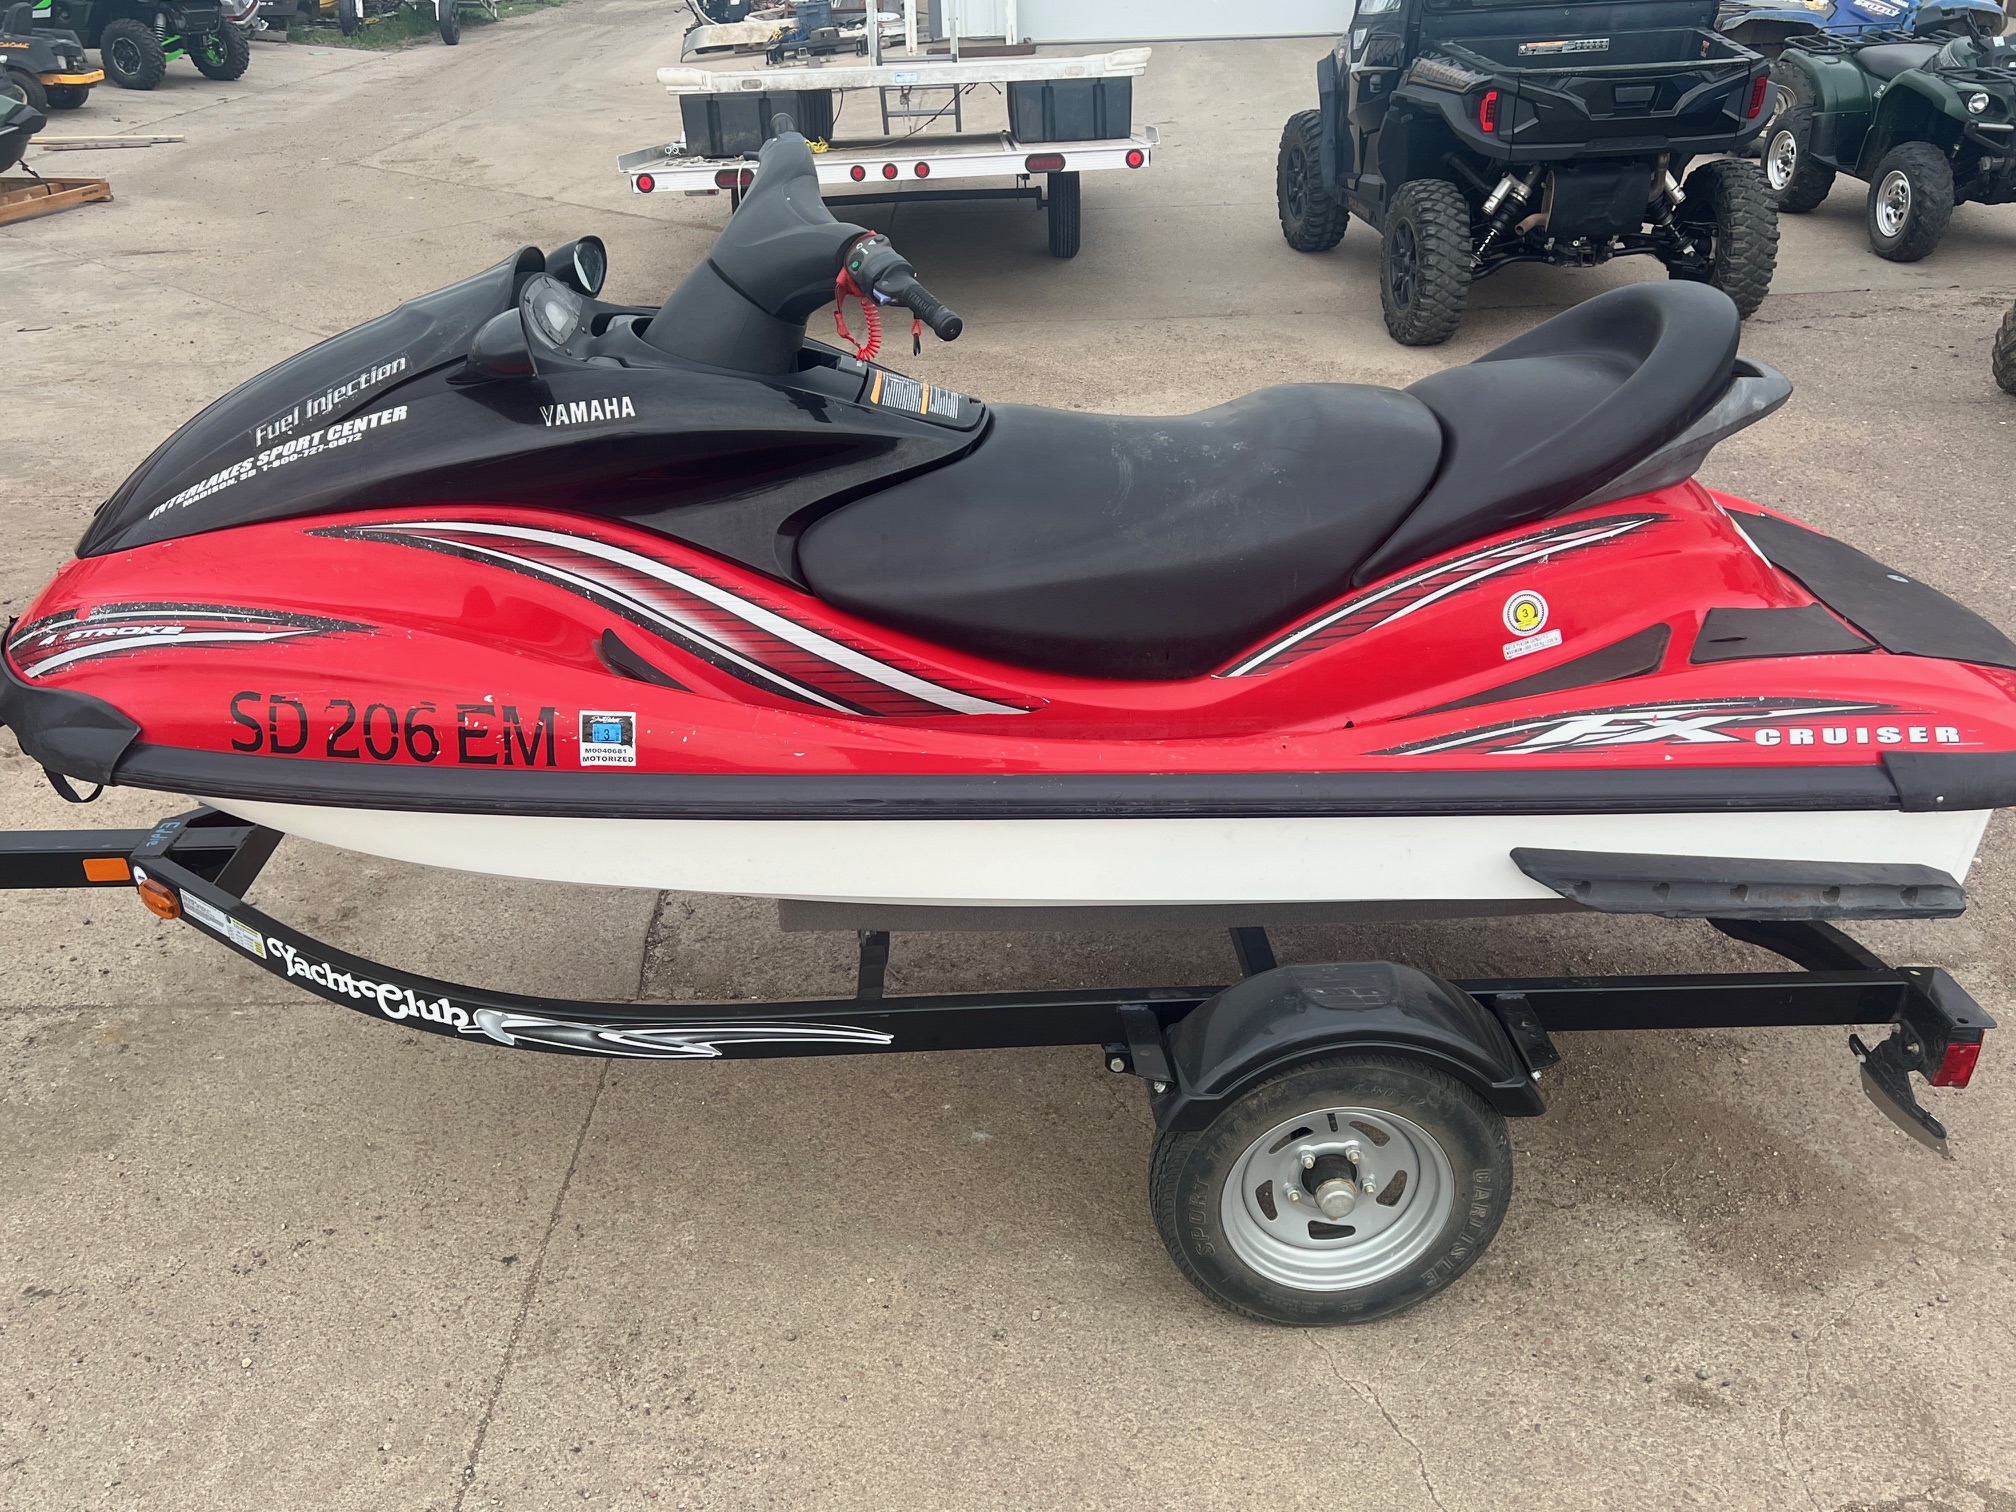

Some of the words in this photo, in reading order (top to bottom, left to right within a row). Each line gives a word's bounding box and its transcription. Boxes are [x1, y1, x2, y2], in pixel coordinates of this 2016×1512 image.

[255, 406, 300, 447] Fuel
[305, 356, 407, 417] Injection
[539, 396, 636, 427] YAMAHA
[148, 457, 255, 520] INTERLAKES
[256, 430, 325, 467] SPORT
[326, 405, 408, 441] CENTER
[182, 477, 238, 508] MADISON,
[239, 468, 257, 481] SD
[1521, 608, 1529, 618] 3
[64, 626, 186, 642] STROKE
[230, 691, 308, 754] SD
[324, 699, 440, 763] 206
[456, 704, 558, 767] EM
[603, 728, 611, 740] 3
[1754, 726, 1962, 746] CRUISER
[582, 755, 634, 763] MOTORIZED
[266, 937, 363, 999] Yacht
[358, 979, 470, 1028] Club
[1188, 1174, 1216, 1256] SPORT
[1420, 1168, 1495, 1286] CARLISLE
